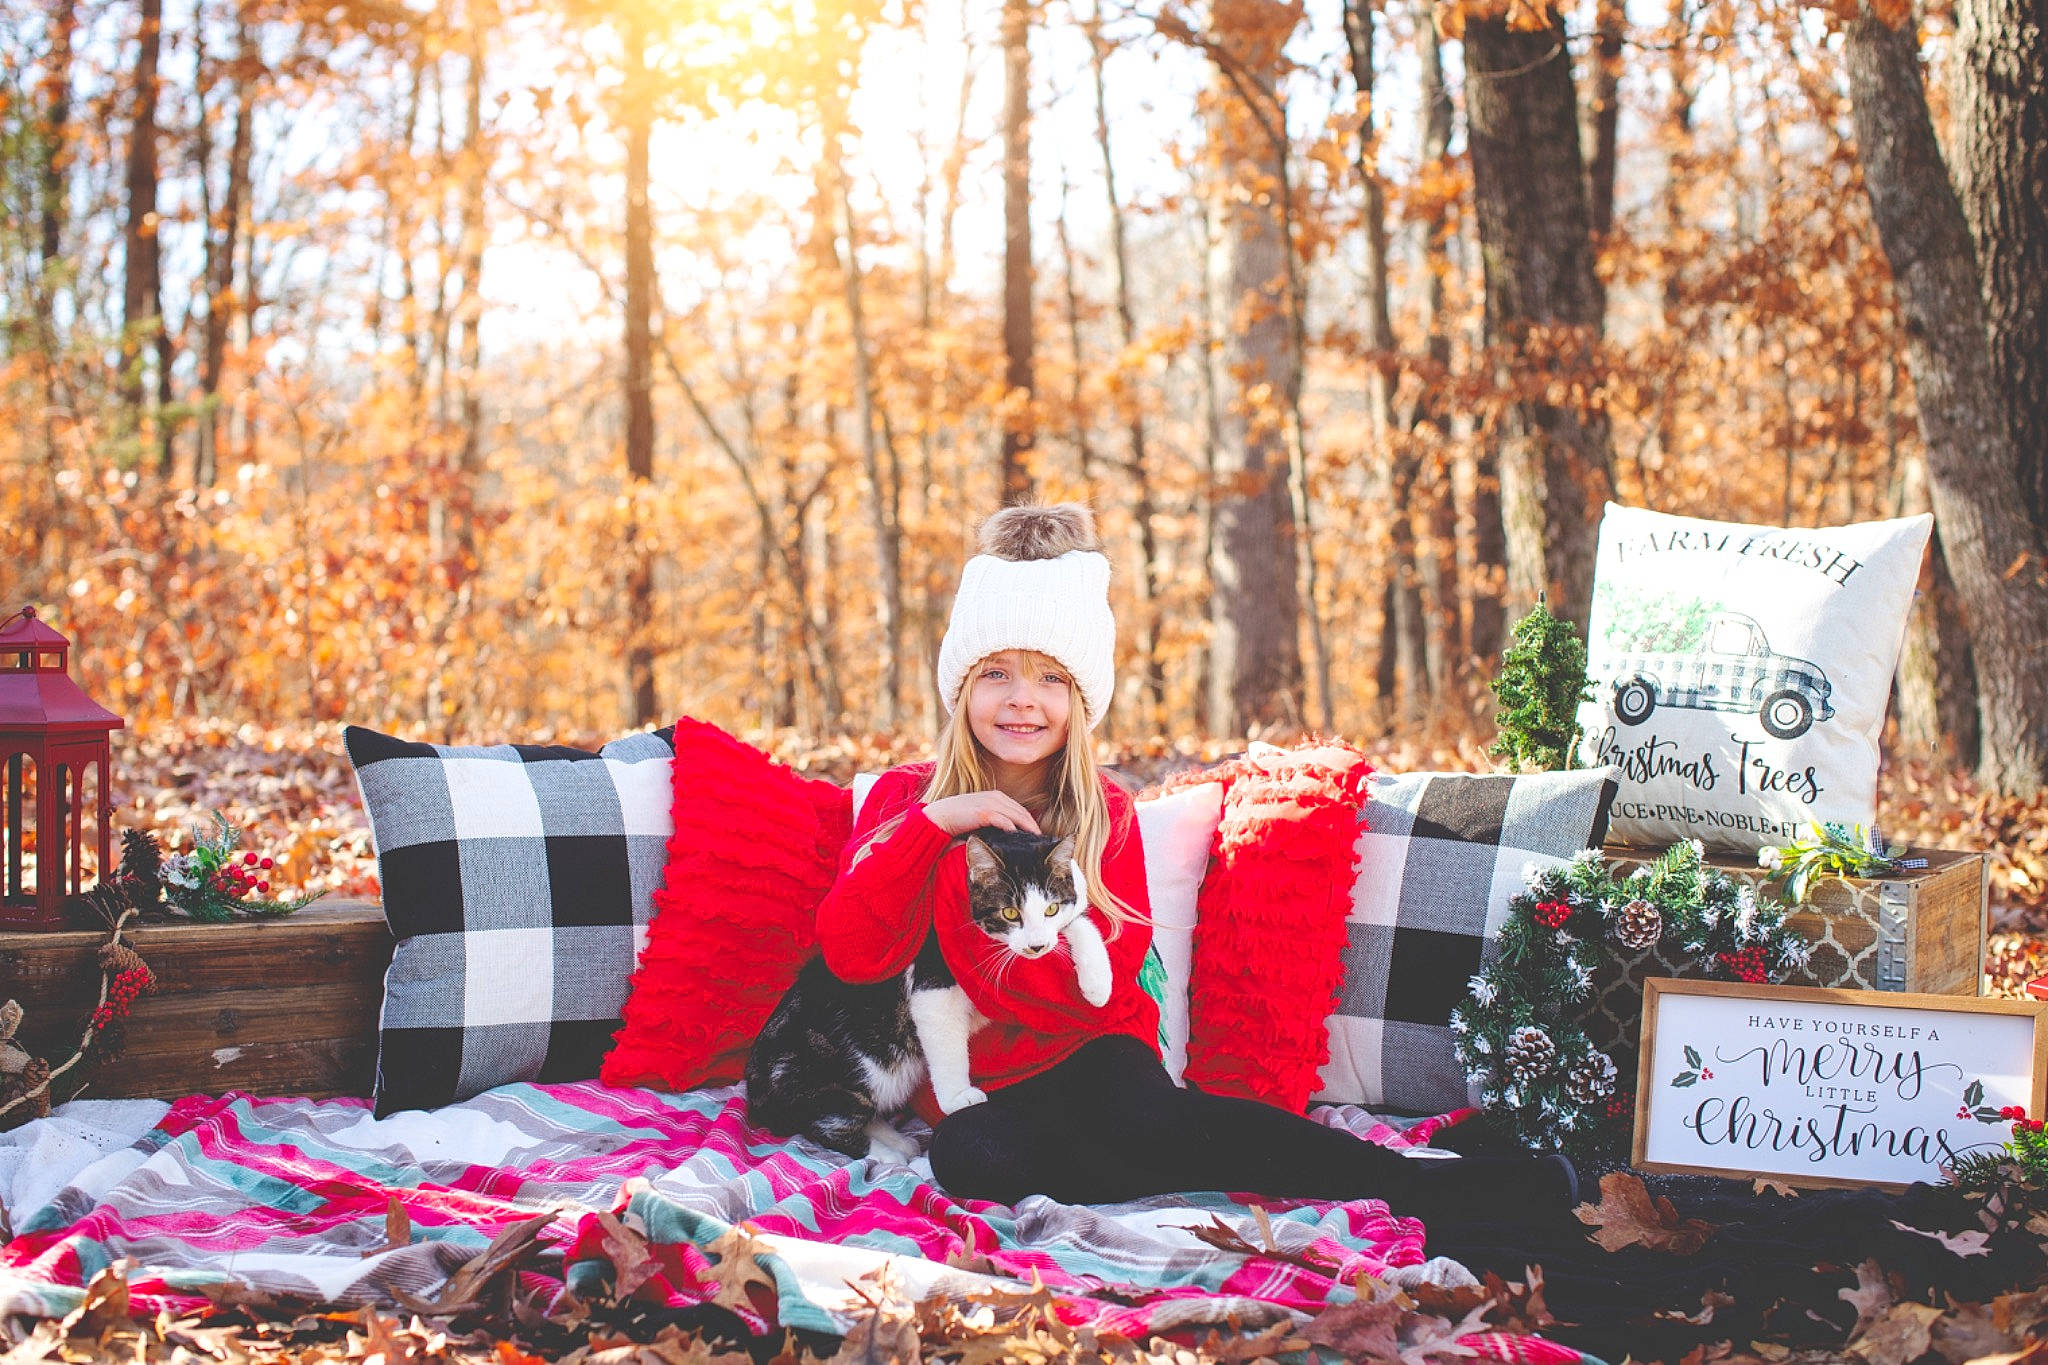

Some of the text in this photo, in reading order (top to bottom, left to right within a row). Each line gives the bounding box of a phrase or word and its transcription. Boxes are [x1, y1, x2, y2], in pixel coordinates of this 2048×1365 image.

[1617, 530, 1865, 588] FARM FRESH
[1730, 732, 1825, 805] Trees
[1748, 1015, 1940, 1041] HAVE YOURSELF A
[1805, 1085, 1877, 1103] LITTLE
[1683, 1096, 2007, 1167] Christmas
